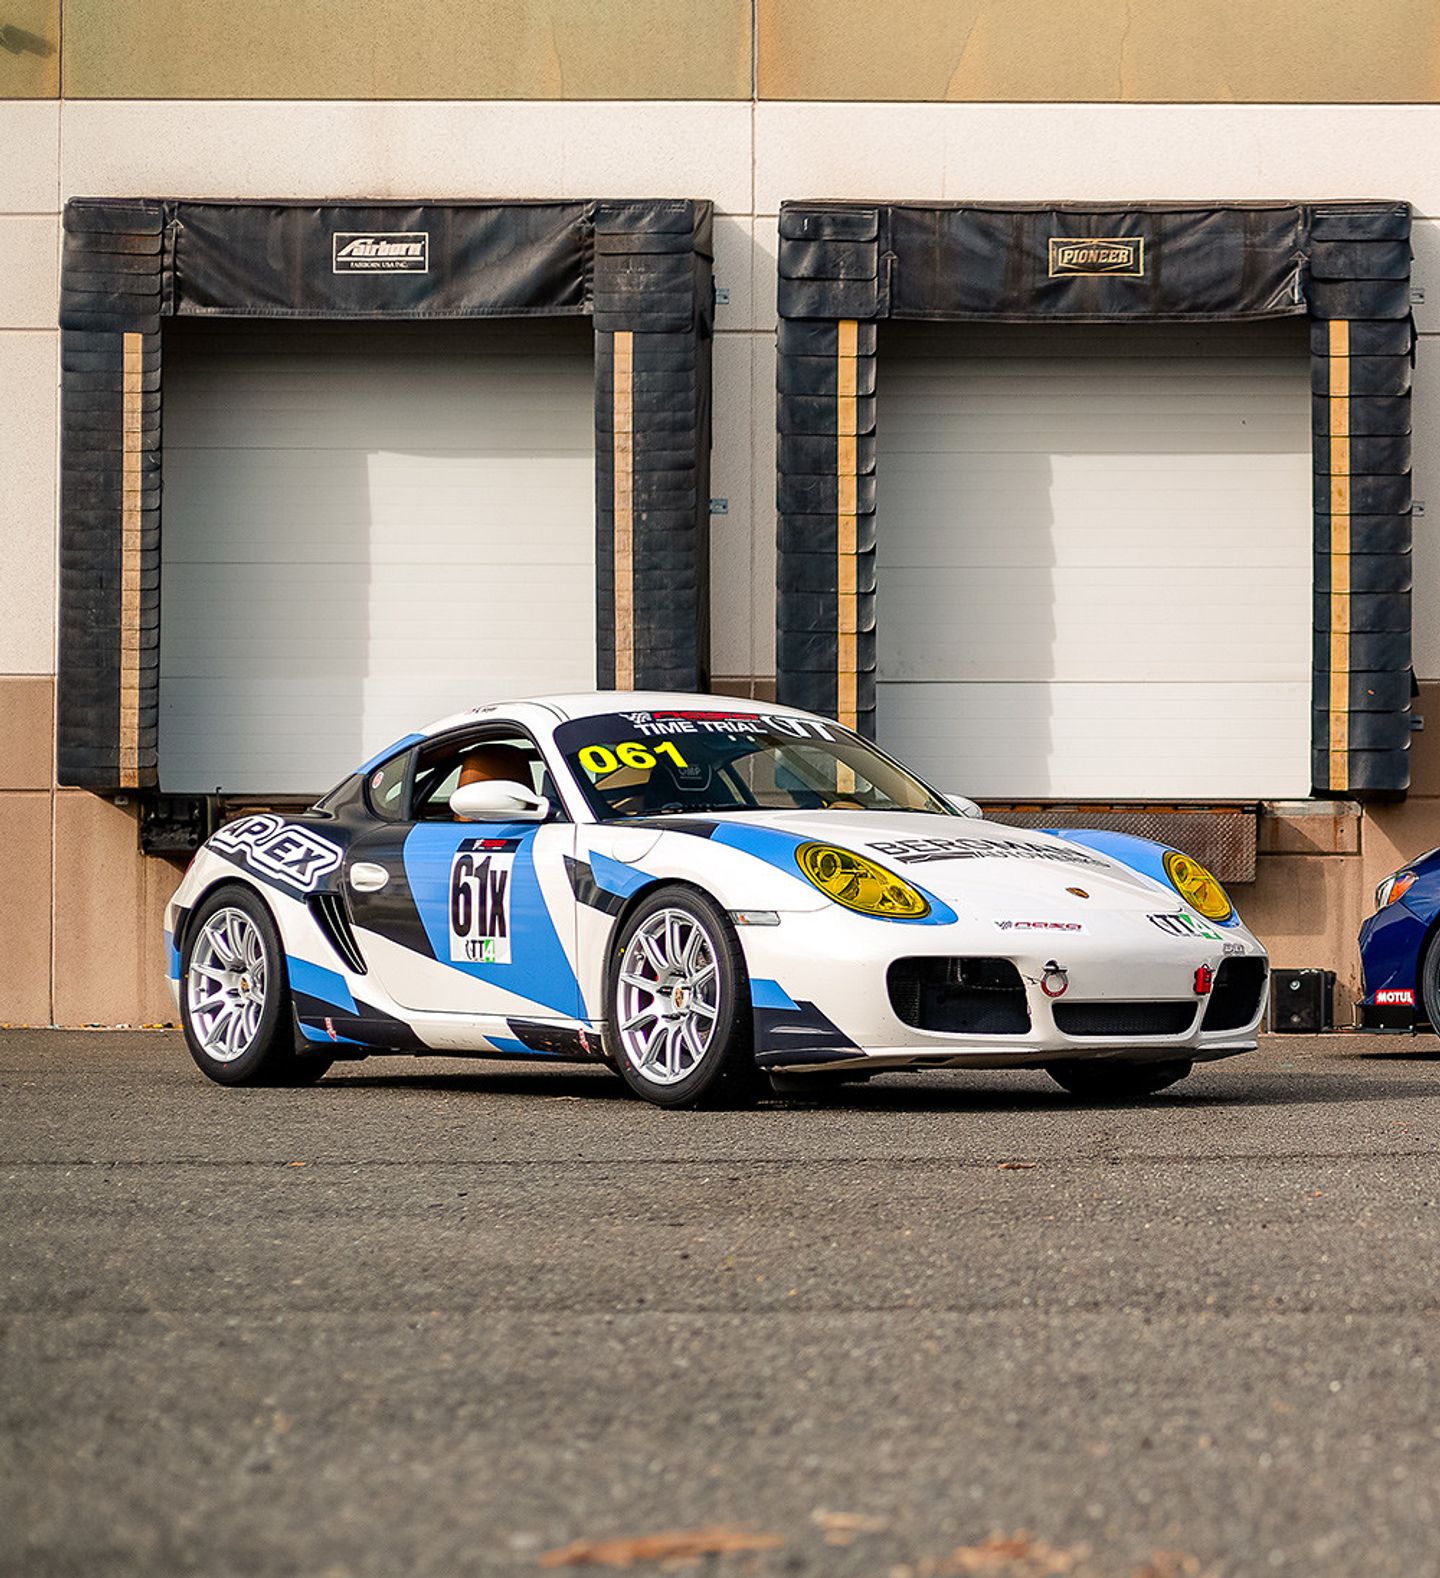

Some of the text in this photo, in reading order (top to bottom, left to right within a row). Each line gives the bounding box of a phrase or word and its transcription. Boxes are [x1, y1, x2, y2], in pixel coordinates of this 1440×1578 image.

[1062, 249, 1129, 264] PIONEER
[634, 721, 768, 736] TIME TRIAL
[578, 741, 688, 774] 061
[222, 818, 327, 877] APEX
[1377, 991, 1413, 1004] MOTUL
